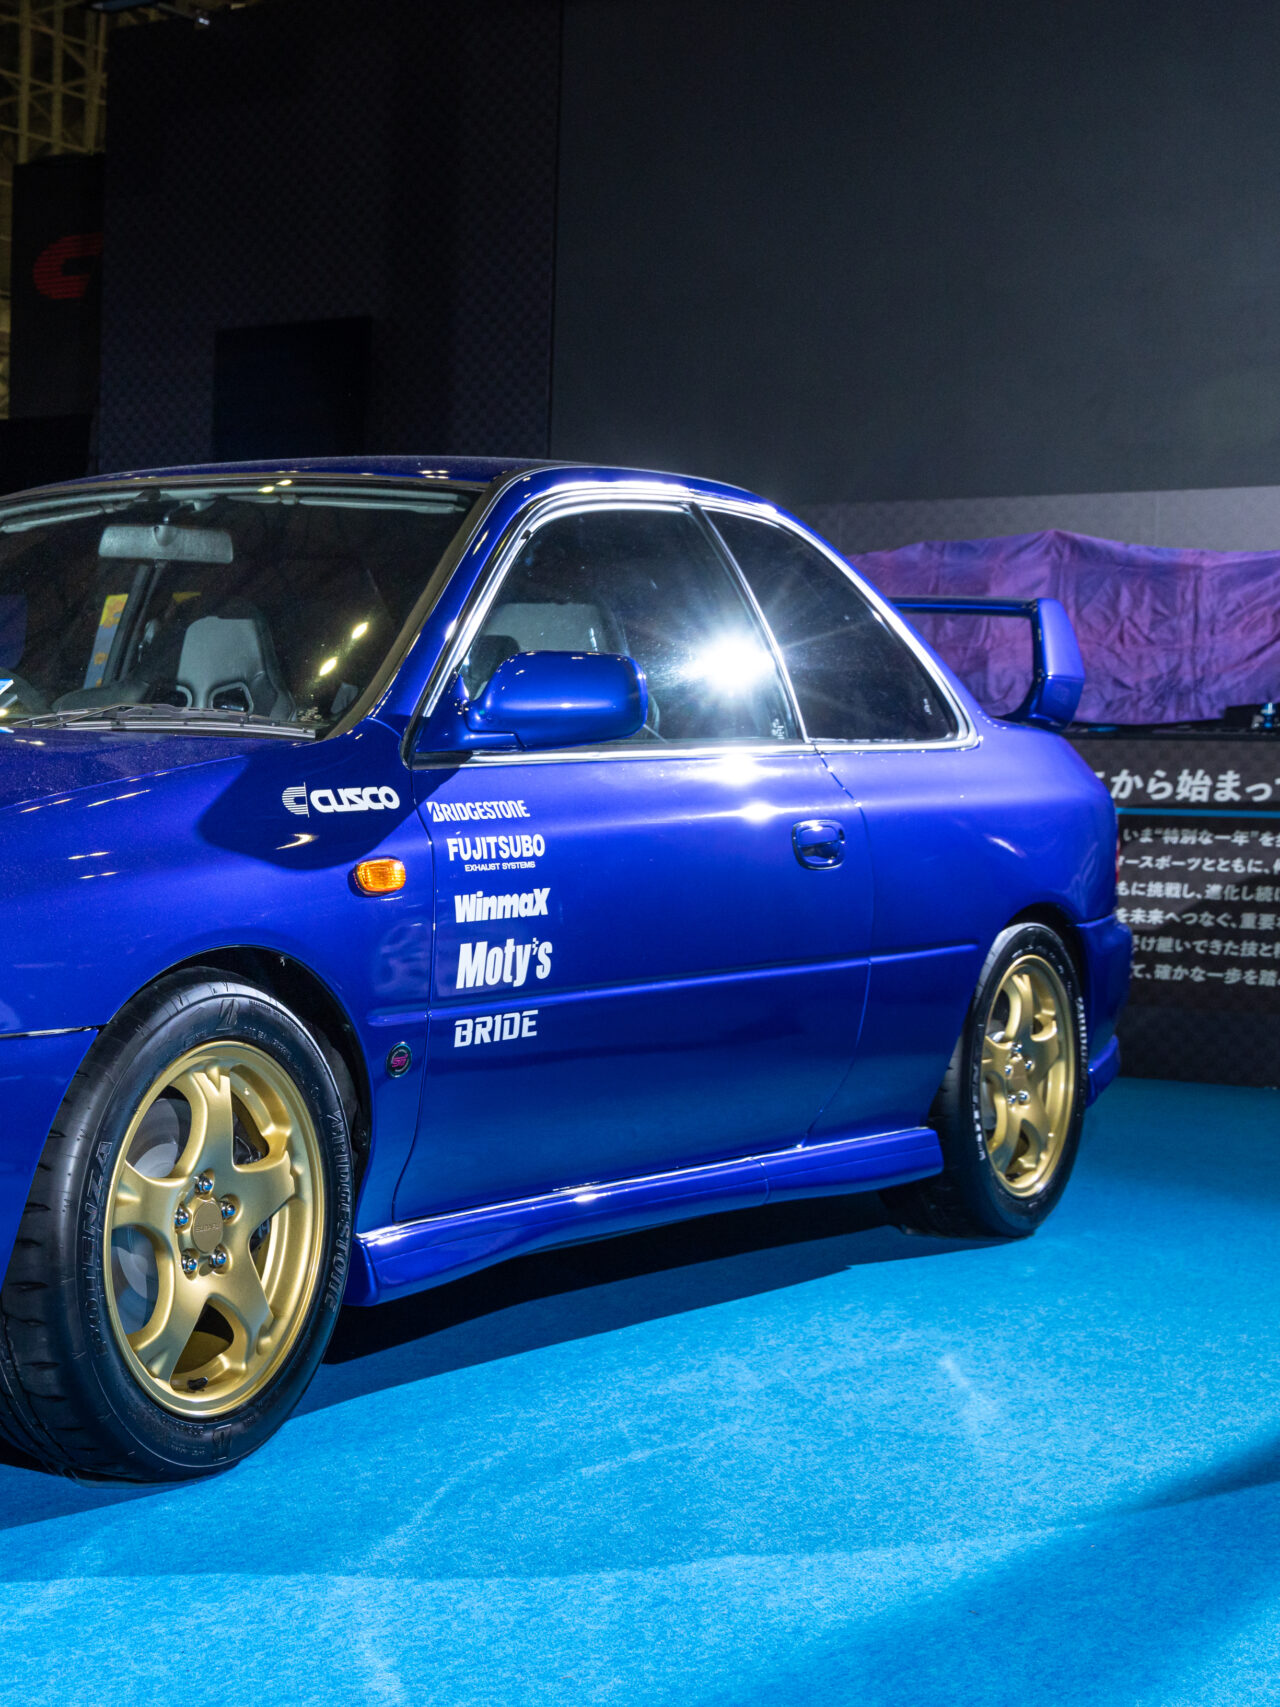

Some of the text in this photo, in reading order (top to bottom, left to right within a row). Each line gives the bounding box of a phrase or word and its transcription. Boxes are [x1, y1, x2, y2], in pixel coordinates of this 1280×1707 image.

[309, 785, 401, 814] CUSCO
[1094, 769, 1280, 803] から始まっ
[425, 799, 531, 823] BRIDGESTONE
[446, 834, 546, 861] FUJITSUBO
[464, 861, 536, 872] EXHAUST SYSTEMS
[455, 937, 553, 990] Moty's
[454, 1009, 539, 1048] BRIDE
